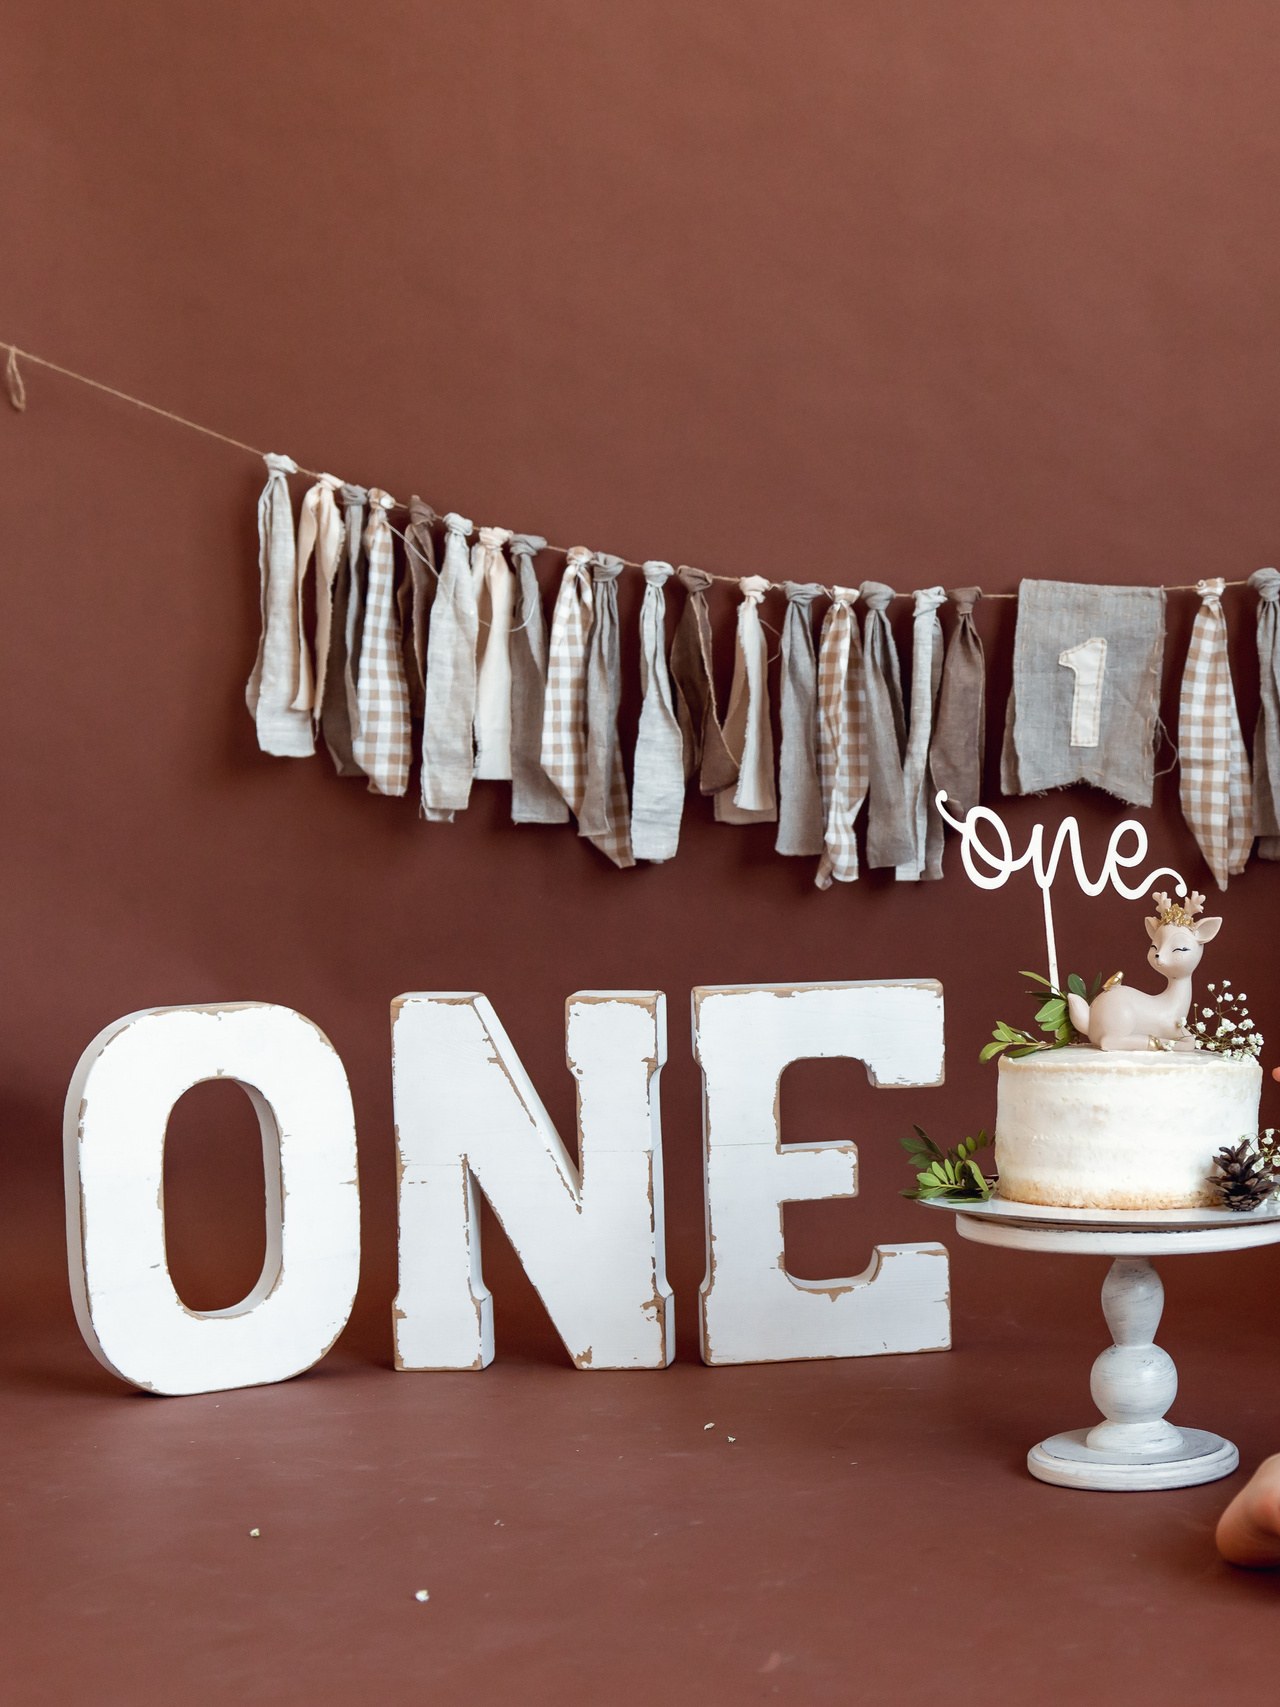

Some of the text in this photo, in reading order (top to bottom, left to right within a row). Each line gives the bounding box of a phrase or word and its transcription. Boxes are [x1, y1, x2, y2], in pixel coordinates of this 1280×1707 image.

[1058, 637, 1107, 747] 1
[935, 789, 1188, 900] one
[63, 978, 952, 1397] ONE
